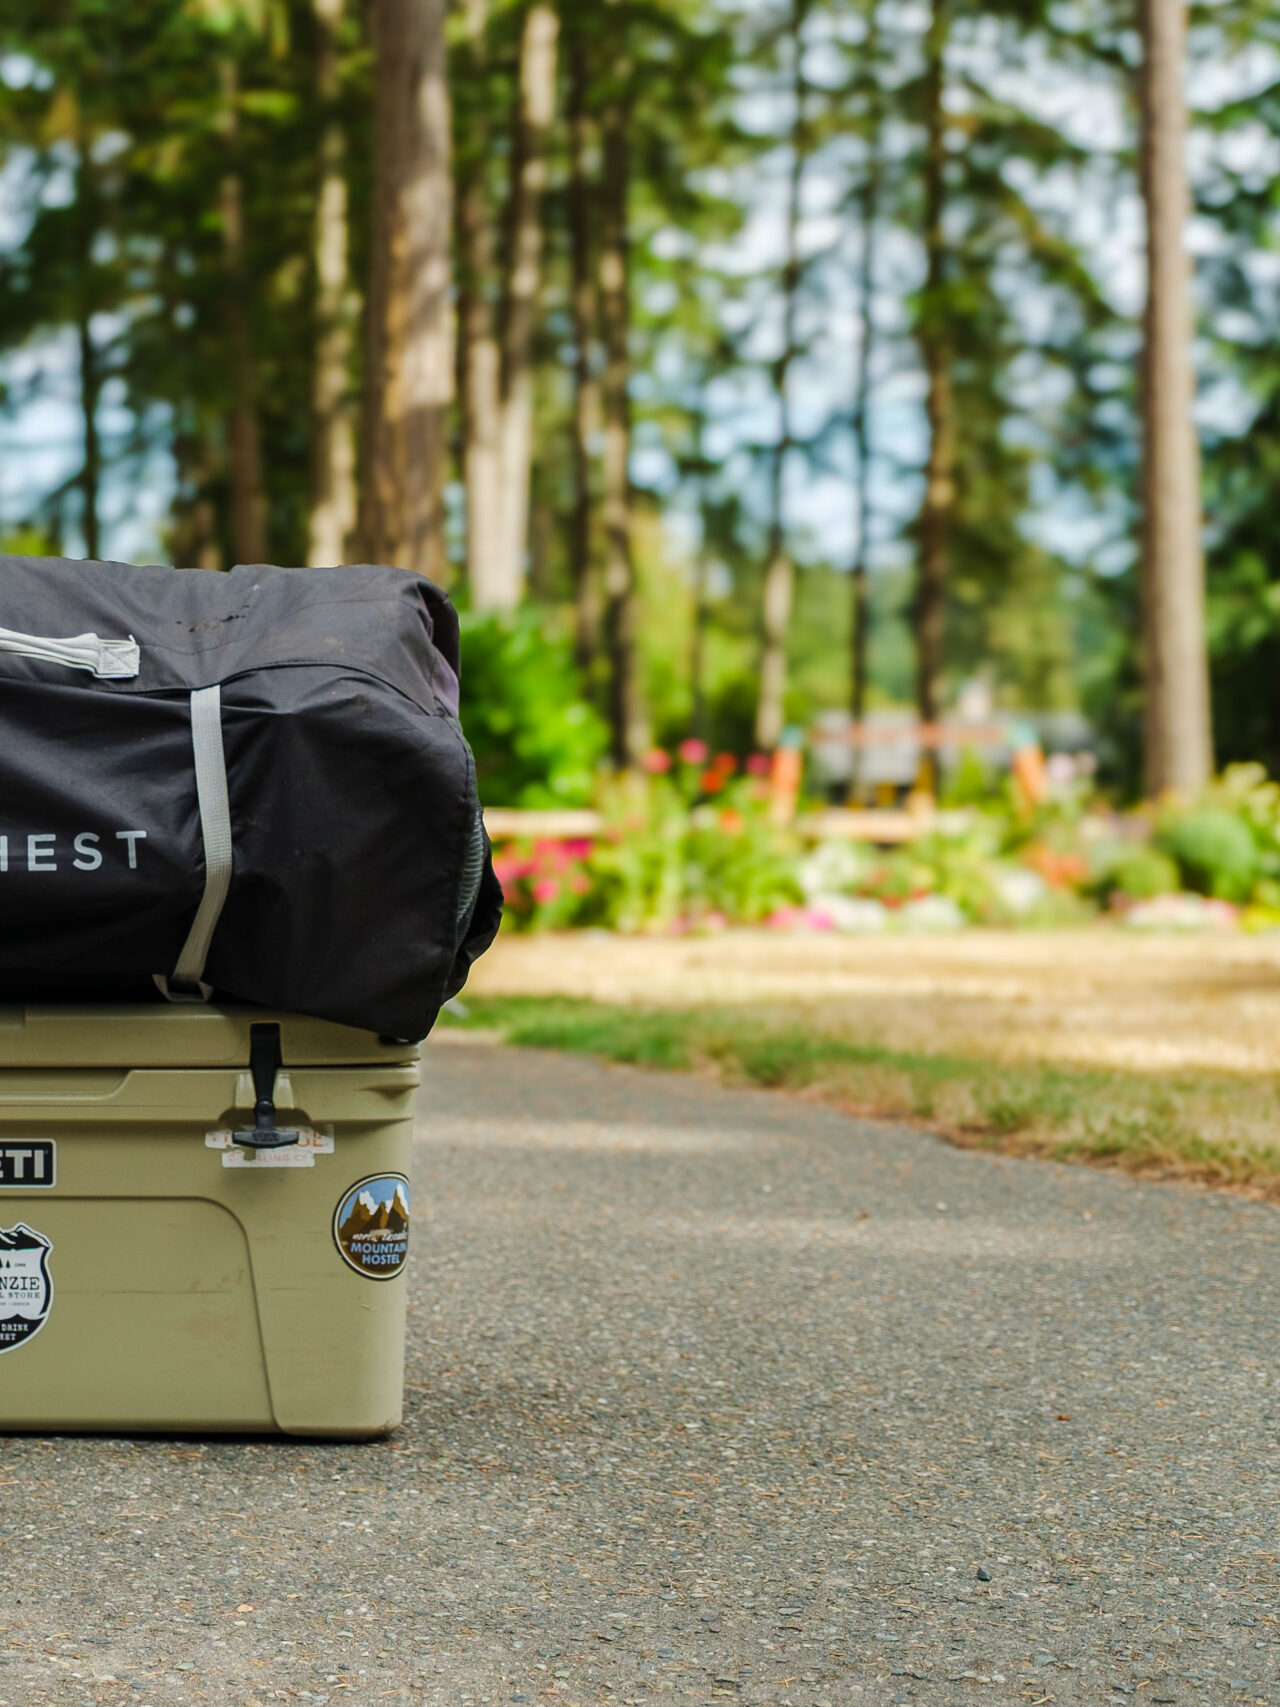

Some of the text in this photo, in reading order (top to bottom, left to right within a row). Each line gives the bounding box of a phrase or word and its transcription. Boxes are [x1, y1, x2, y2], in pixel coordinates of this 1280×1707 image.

[362, 1254, 401, 1265] HOSTEL
[7, 1291, 41, 1299] STORE
[1, 1323, 29, 1332] DRINK
